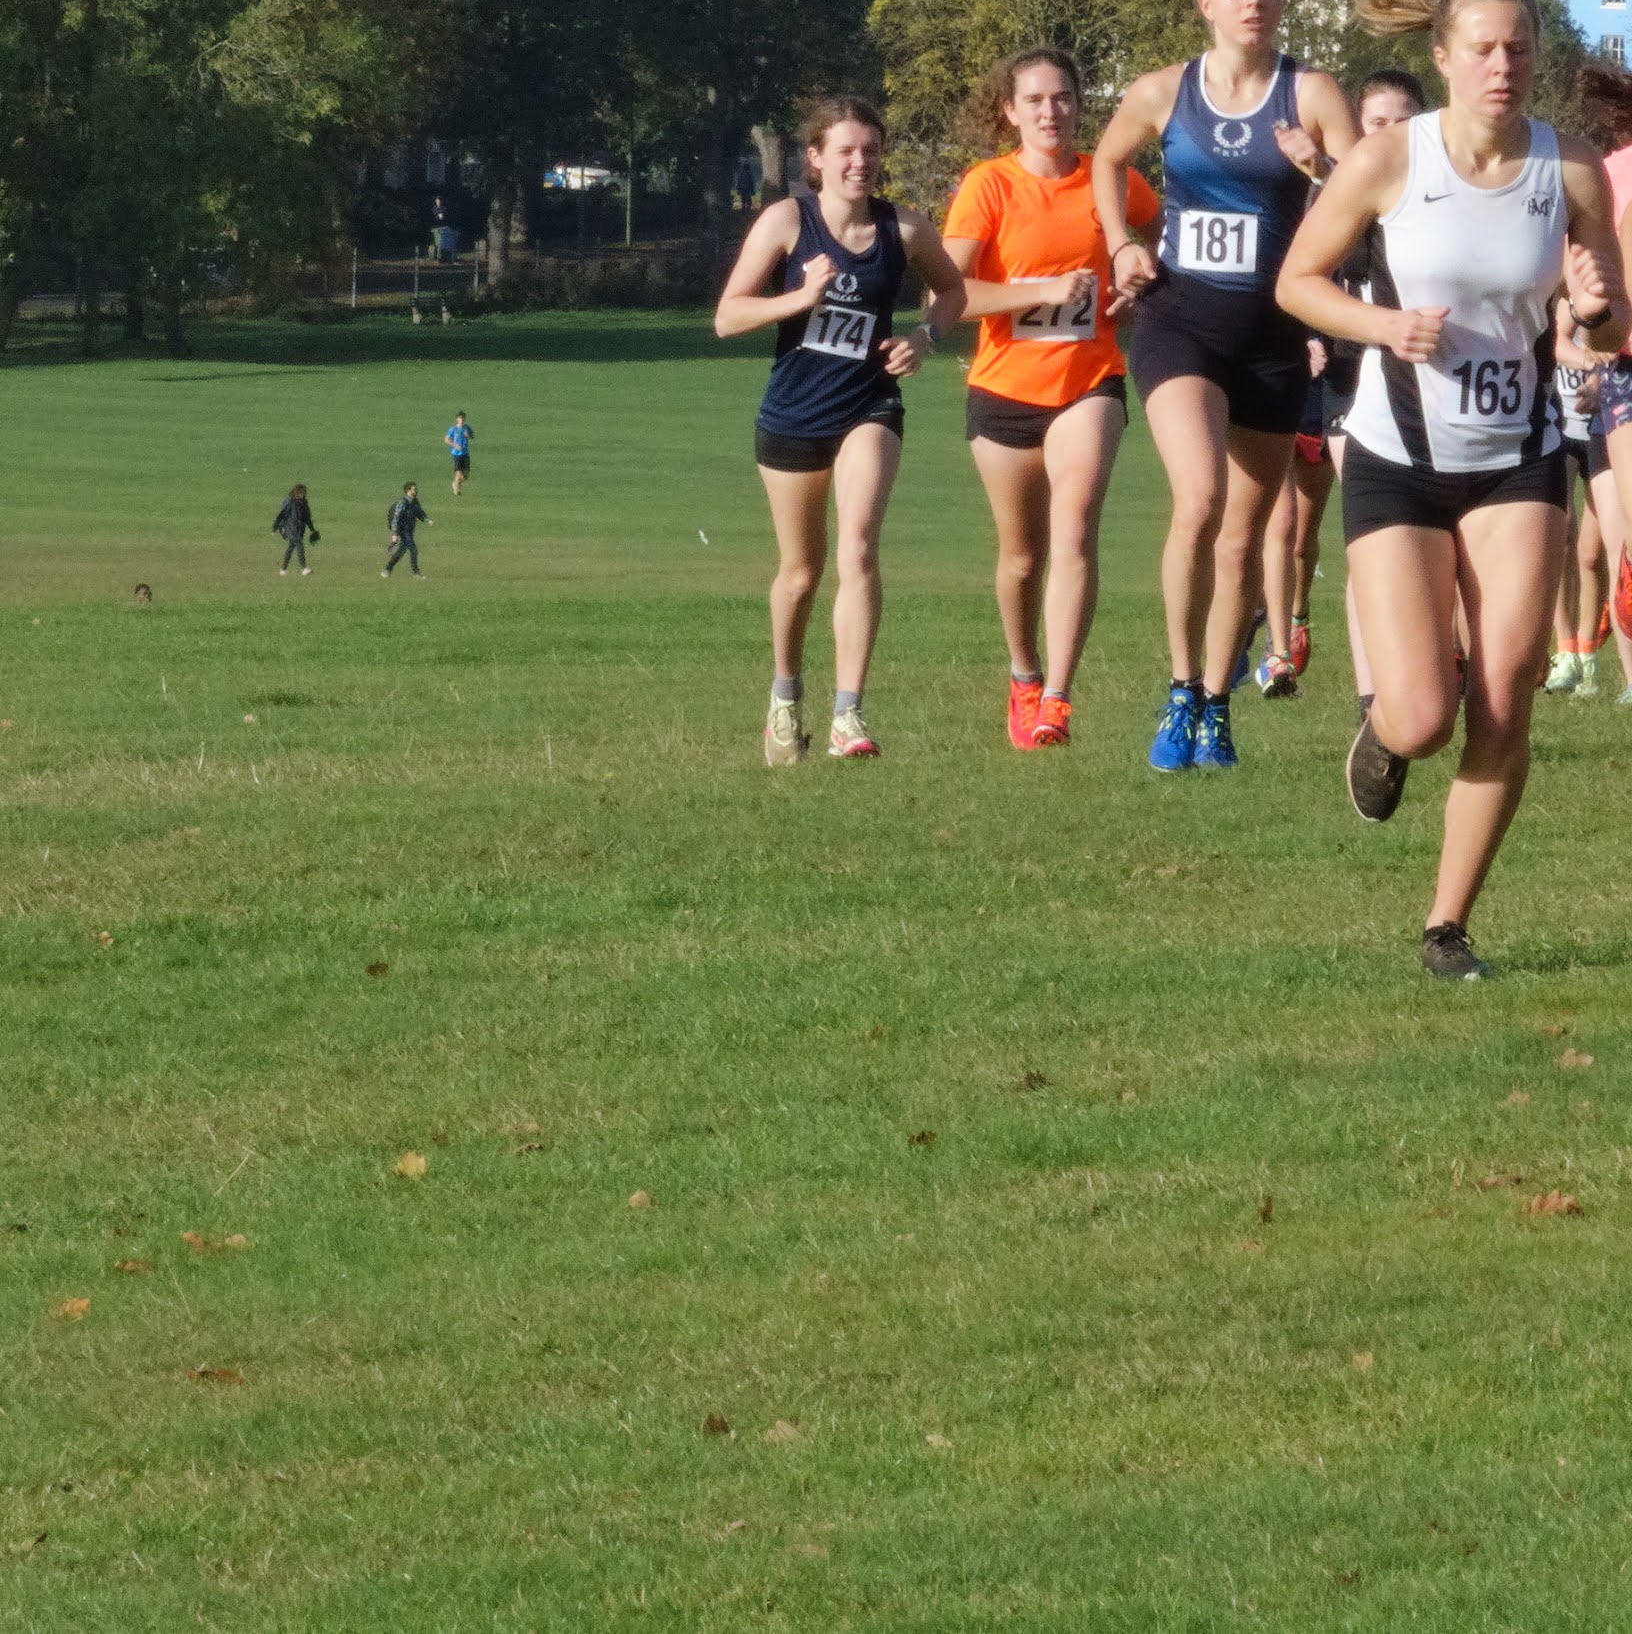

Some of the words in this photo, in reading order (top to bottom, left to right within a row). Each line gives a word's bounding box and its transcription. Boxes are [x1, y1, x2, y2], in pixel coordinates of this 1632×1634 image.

[1189, 217, 1246, 265] 181
[817, 310, 868, 352] 174
[1452, 359, 1522, 416] 163
